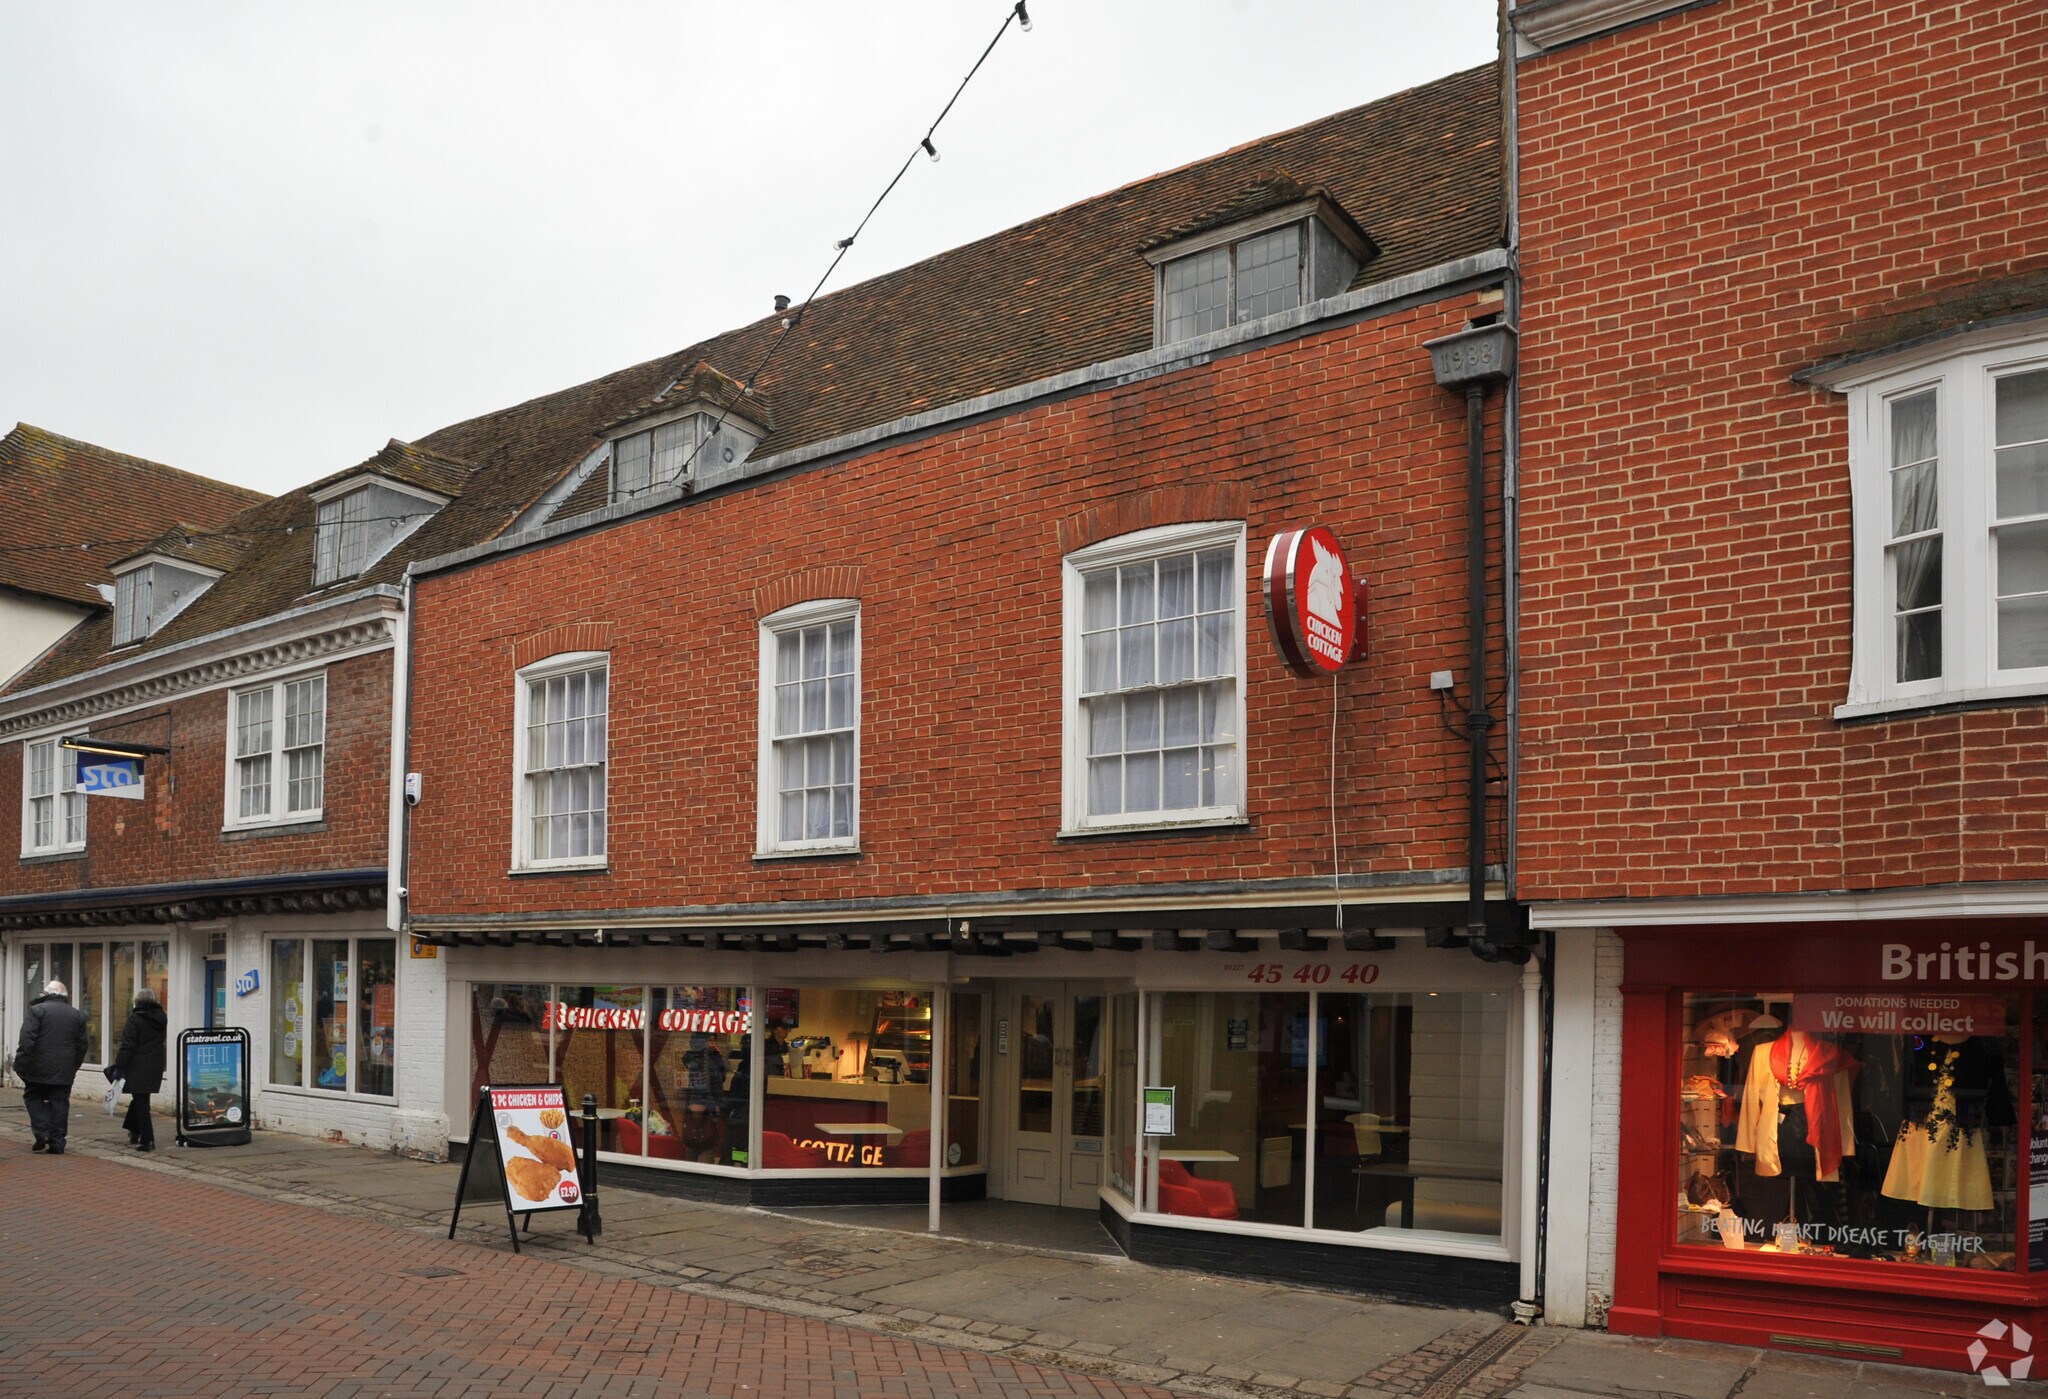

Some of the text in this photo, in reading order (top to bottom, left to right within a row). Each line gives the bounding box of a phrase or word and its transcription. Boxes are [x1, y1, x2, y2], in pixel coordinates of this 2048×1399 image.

[1440, 341, 1492, 373] 1988
[1306, 615, 1342, 646] CHICKEN
[1307, 633, 1343, 663] COTTAGE
[84, 764, 133, 788] sta
[1881, 940, 2048, 981] British
[1247, 963, 1284, 984] 45
[1293, 963, 1331, 984] 40
[1340, 963, 1380, 985] 40
[1834, 996, 1907, 1009] DONATIONS
[1909, 998, 1960, 1010] NEEDED
[565, 1006, 751, 1034] CHICKEN COTTAGE
[1821, 1010, 1974, 1033] We will collect
[186, 1034, 243, 1043] statravel.co.uk
[197, 1046, 231, 1065] FEEL IT
[492, 1095, 496, 1107] 2
[497, 1094, 507, 1107] PC
[508, 1093, 536, 1107] CHICKEN
[543, 1093, 563, 1106] CHIPS
[560, 1186, 577, 1198] £2.99
[1700, 1214, 1765, 1238] BEATING
[1771, 1222, 1825, 1241] HEART
[1828, 1224, 1888, 1246] DISEASE
[1893, 1229, 1986, 1254] TOGETHER
